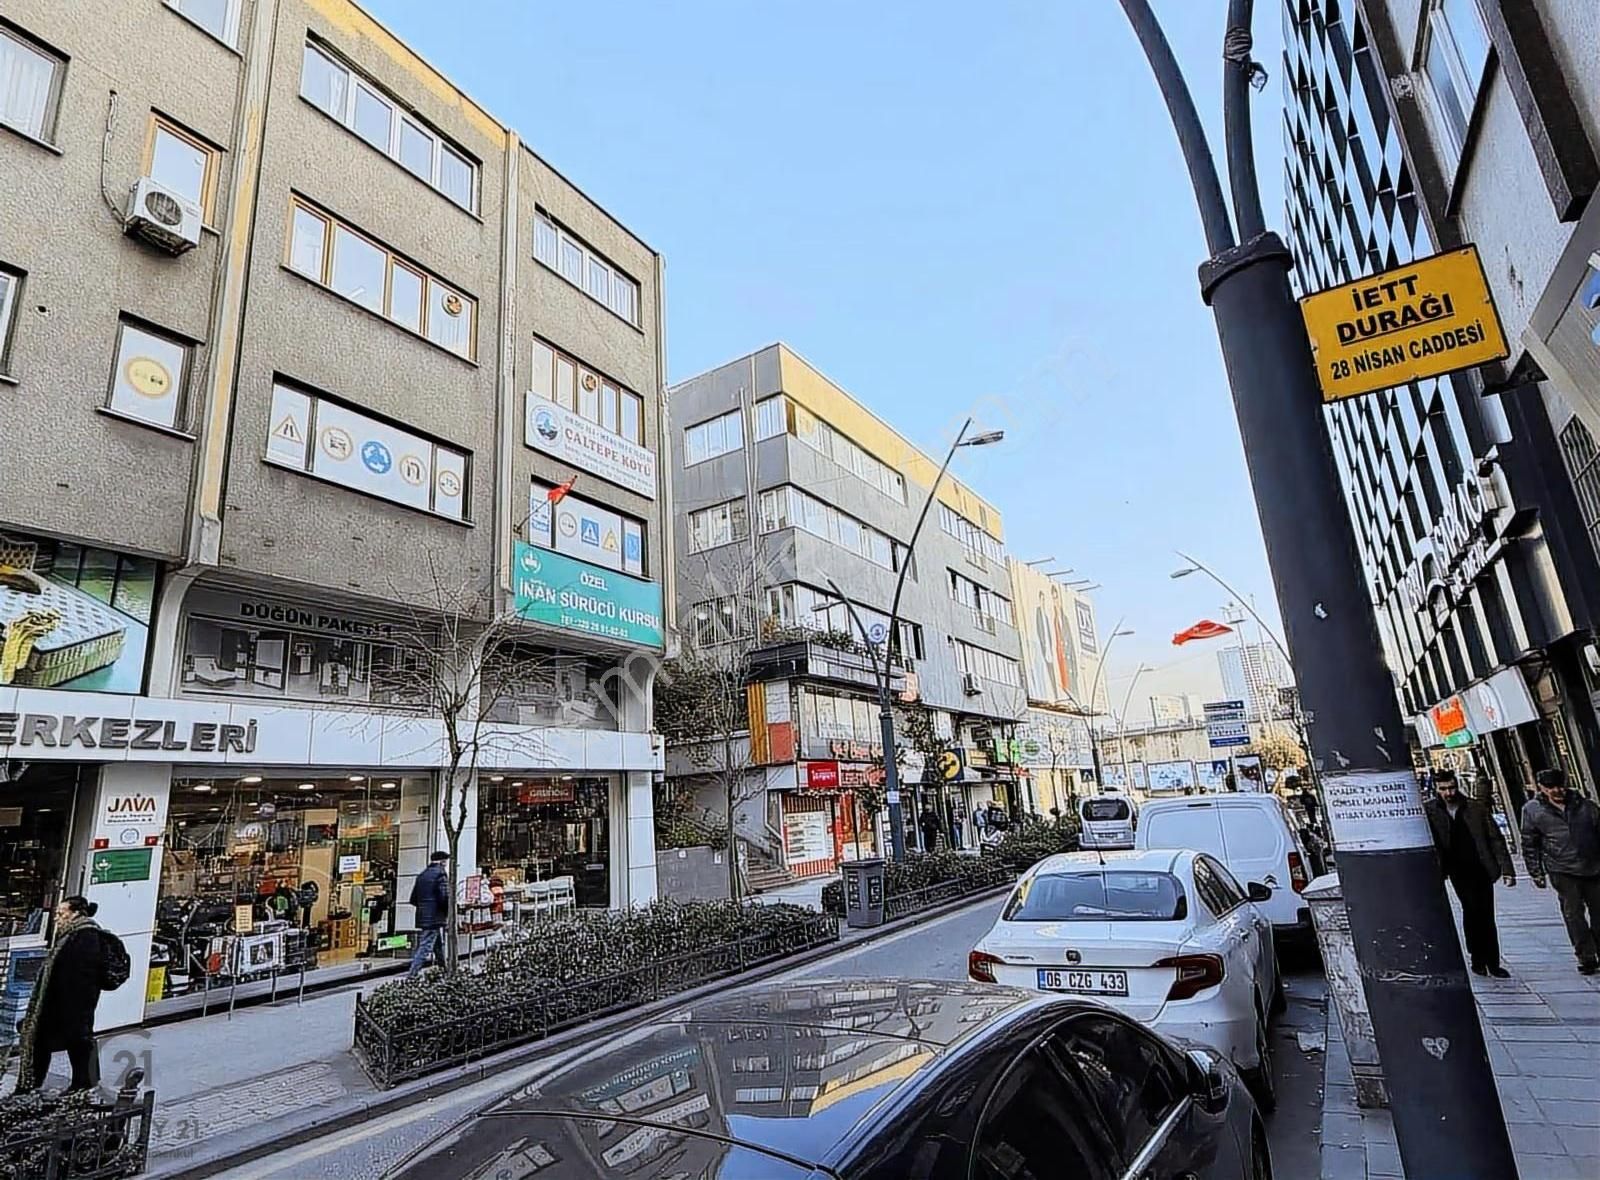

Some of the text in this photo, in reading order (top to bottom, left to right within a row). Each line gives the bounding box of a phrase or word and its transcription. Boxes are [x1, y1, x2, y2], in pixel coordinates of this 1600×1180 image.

[1352, 275, 1418, 312] İETT
[1336, 292, 1454, 344] DURAĞI
[1331, 318, 1485, 380] 28 NİSAN CADDESİ
[580, 570, 608, 591] ÖZEL
[240, 602, 313, 626] DÜĞÜN
[519, 577, 659, 629] İNAN SÜRÜCÜ KURSU
[107, 797, 156, 813] JAVA
[1046, 972, 1124, 990] 06 CZG 433
